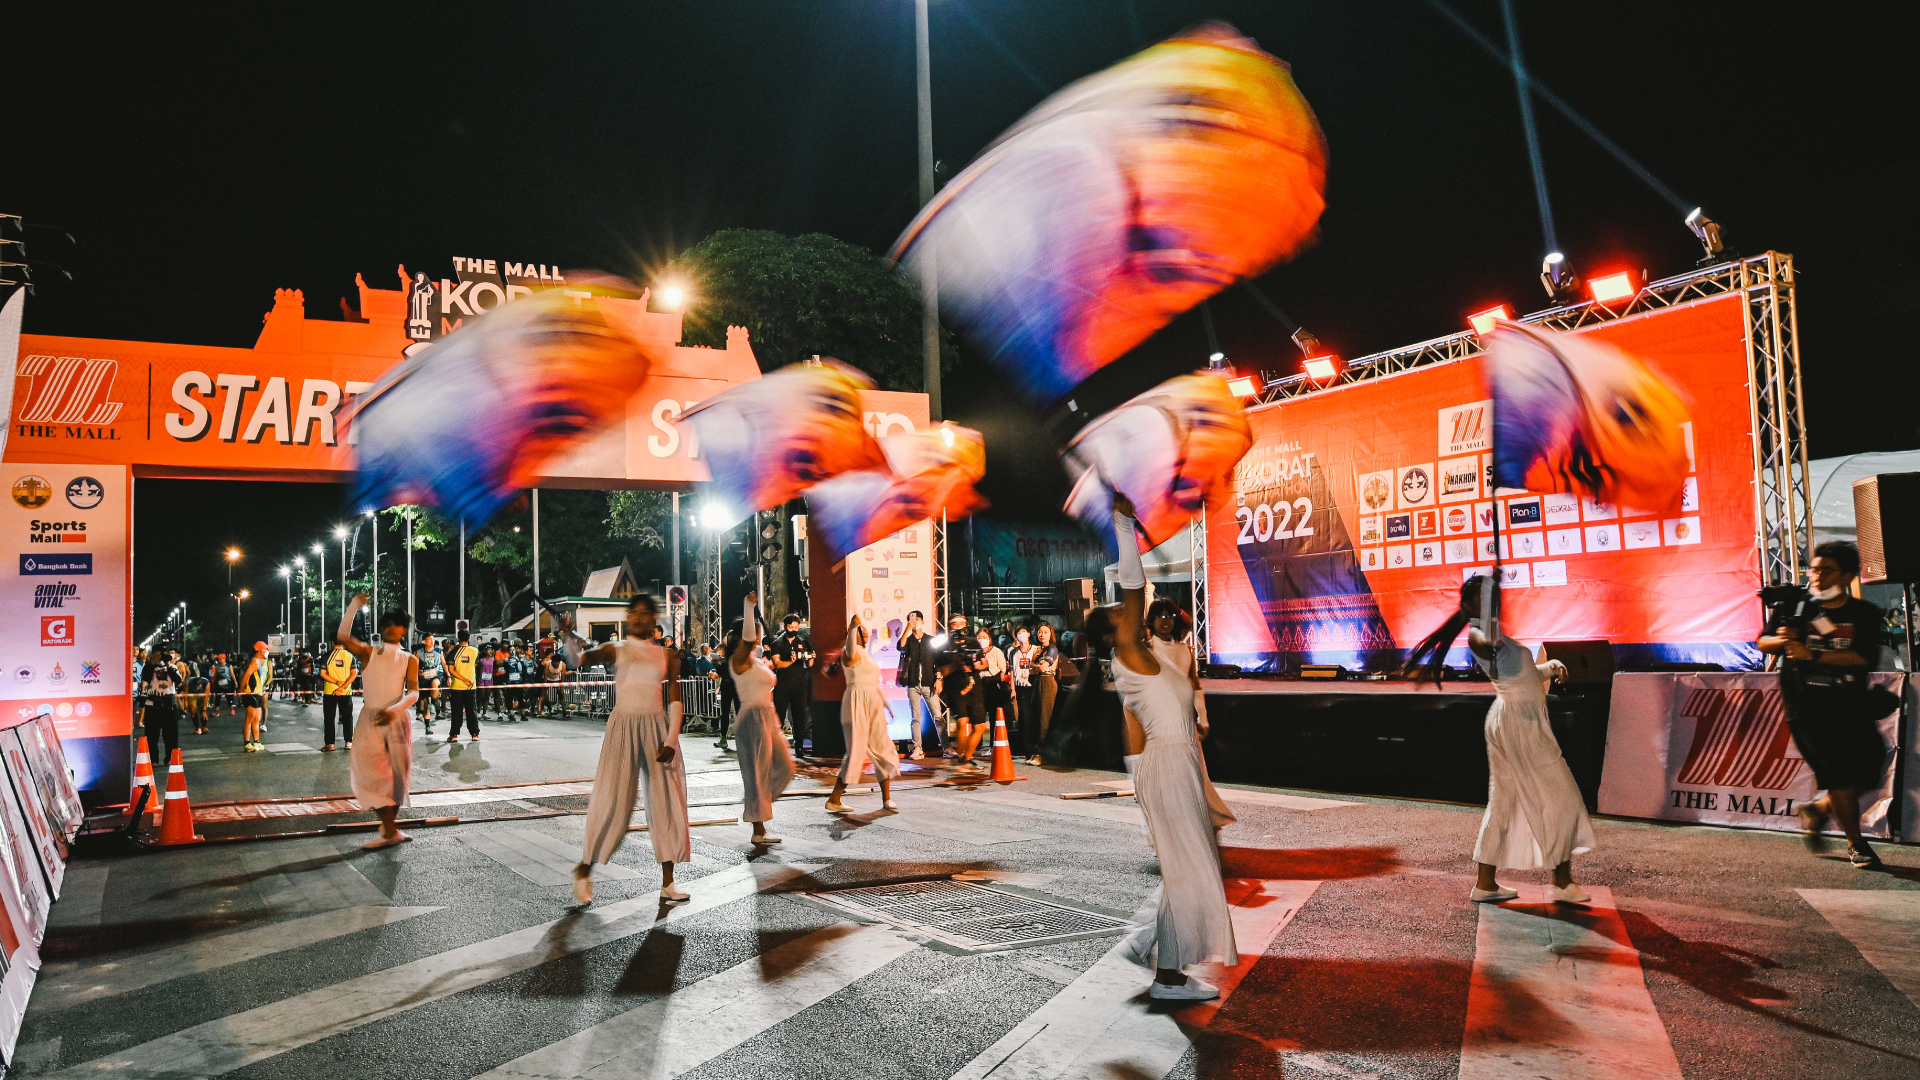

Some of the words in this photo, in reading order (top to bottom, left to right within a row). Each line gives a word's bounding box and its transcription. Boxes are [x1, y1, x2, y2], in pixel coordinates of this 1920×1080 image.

[452, 256, 497, 274] THE
[504, 261, 565, 281] MALL
[16, 424, 57, 438] THE
[65, 426, 122, 441] MALL
[1274, 441, 1302, 454] MALL
[1450, 444, 1464, 452] THE
[1466, 440, 1487, 449] MALL
[1449, 472, 1477, 486] NAKHON
[30, 520, 87, 533] Sports
[1235, 497, 1314, 545] 2022
[30, 533, 61, 543] Mall
[34, 580, 77, 596] amino
[34, 596, 64, 608] VITAL
[47, 619, 67, 638] G
[1670, 789, 1718, 811] THE
[1726, 793, 1800, 817] MALL
